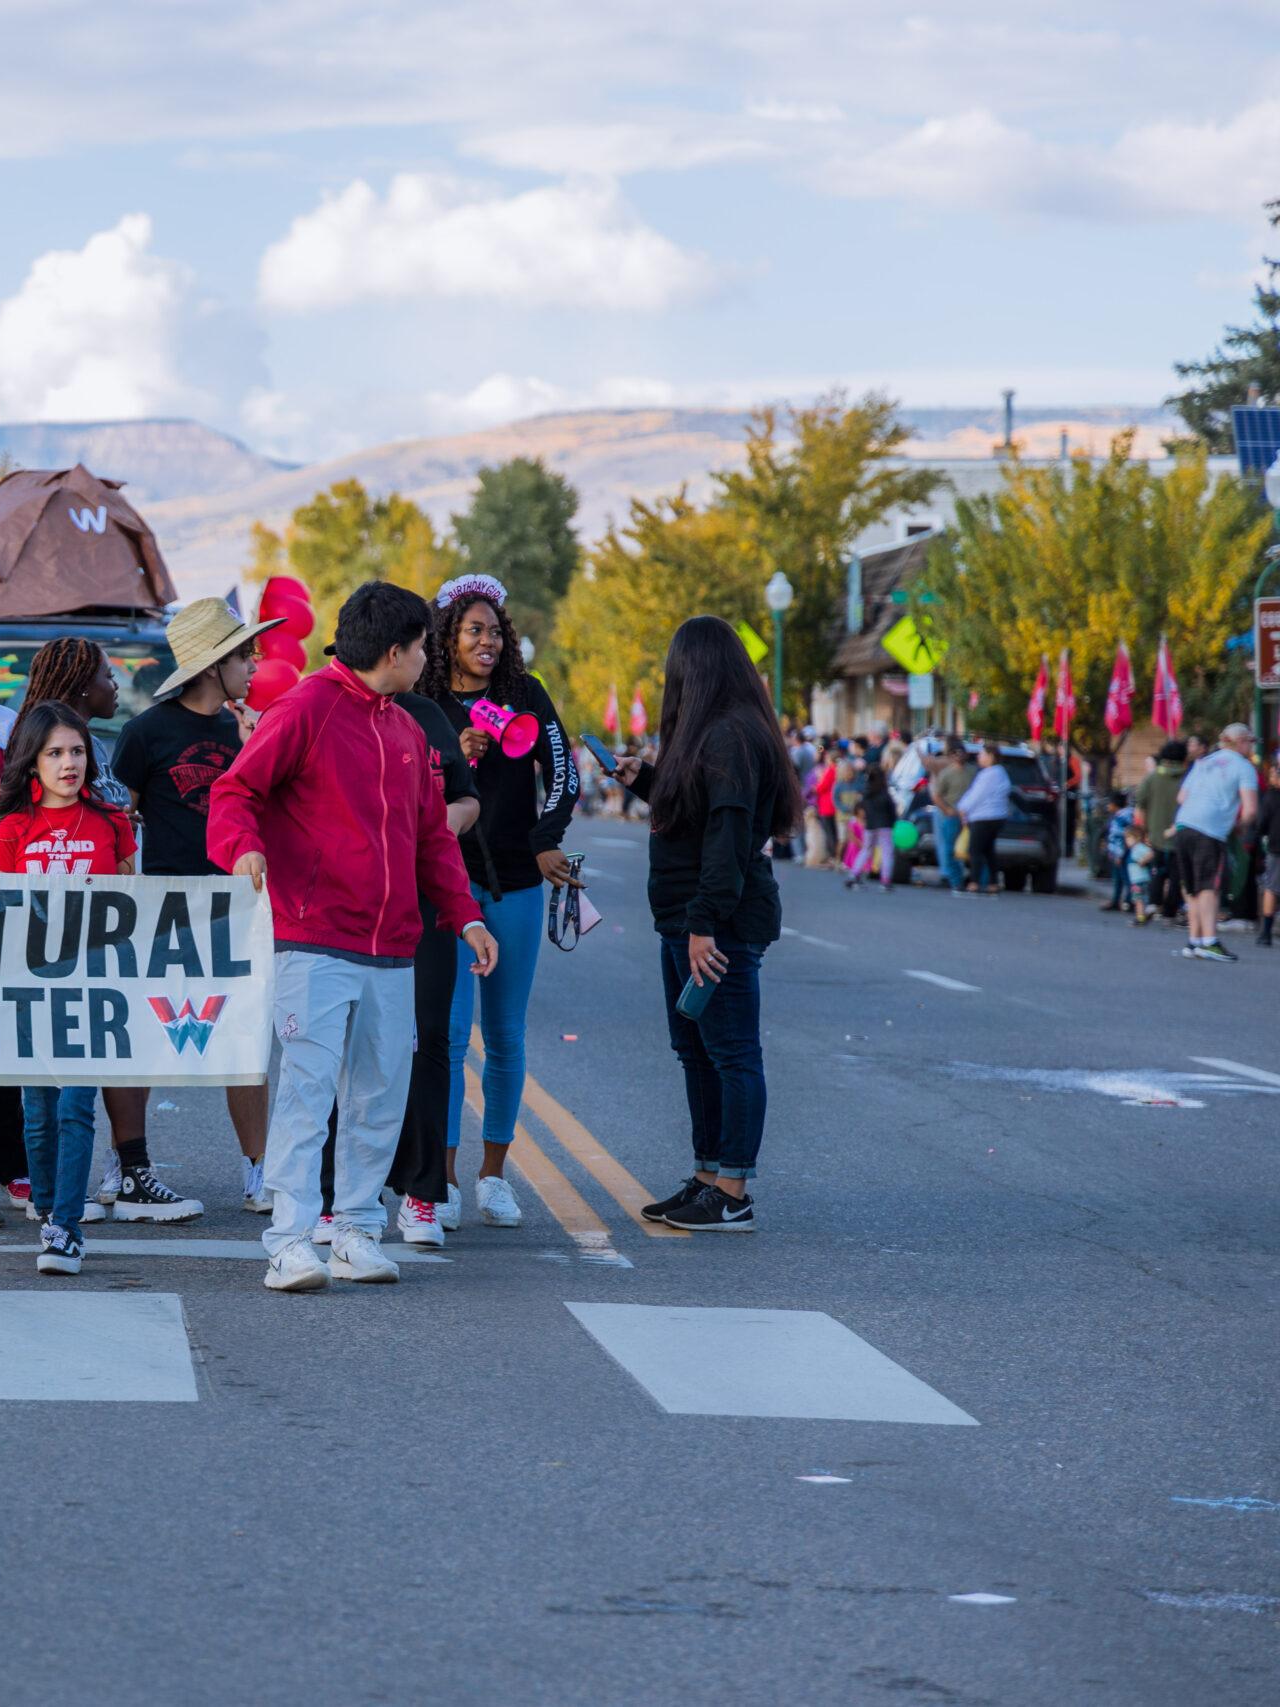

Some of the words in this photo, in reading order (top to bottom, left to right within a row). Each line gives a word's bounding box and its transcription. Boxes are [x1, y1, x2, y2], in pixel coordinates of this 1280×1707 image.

[67, 505, 108, 535] W
[448, 581, 488, 600] BIRTHDAY
[24, 840, 96, 855] BRAND
[46, 853, 73, 861] THE
